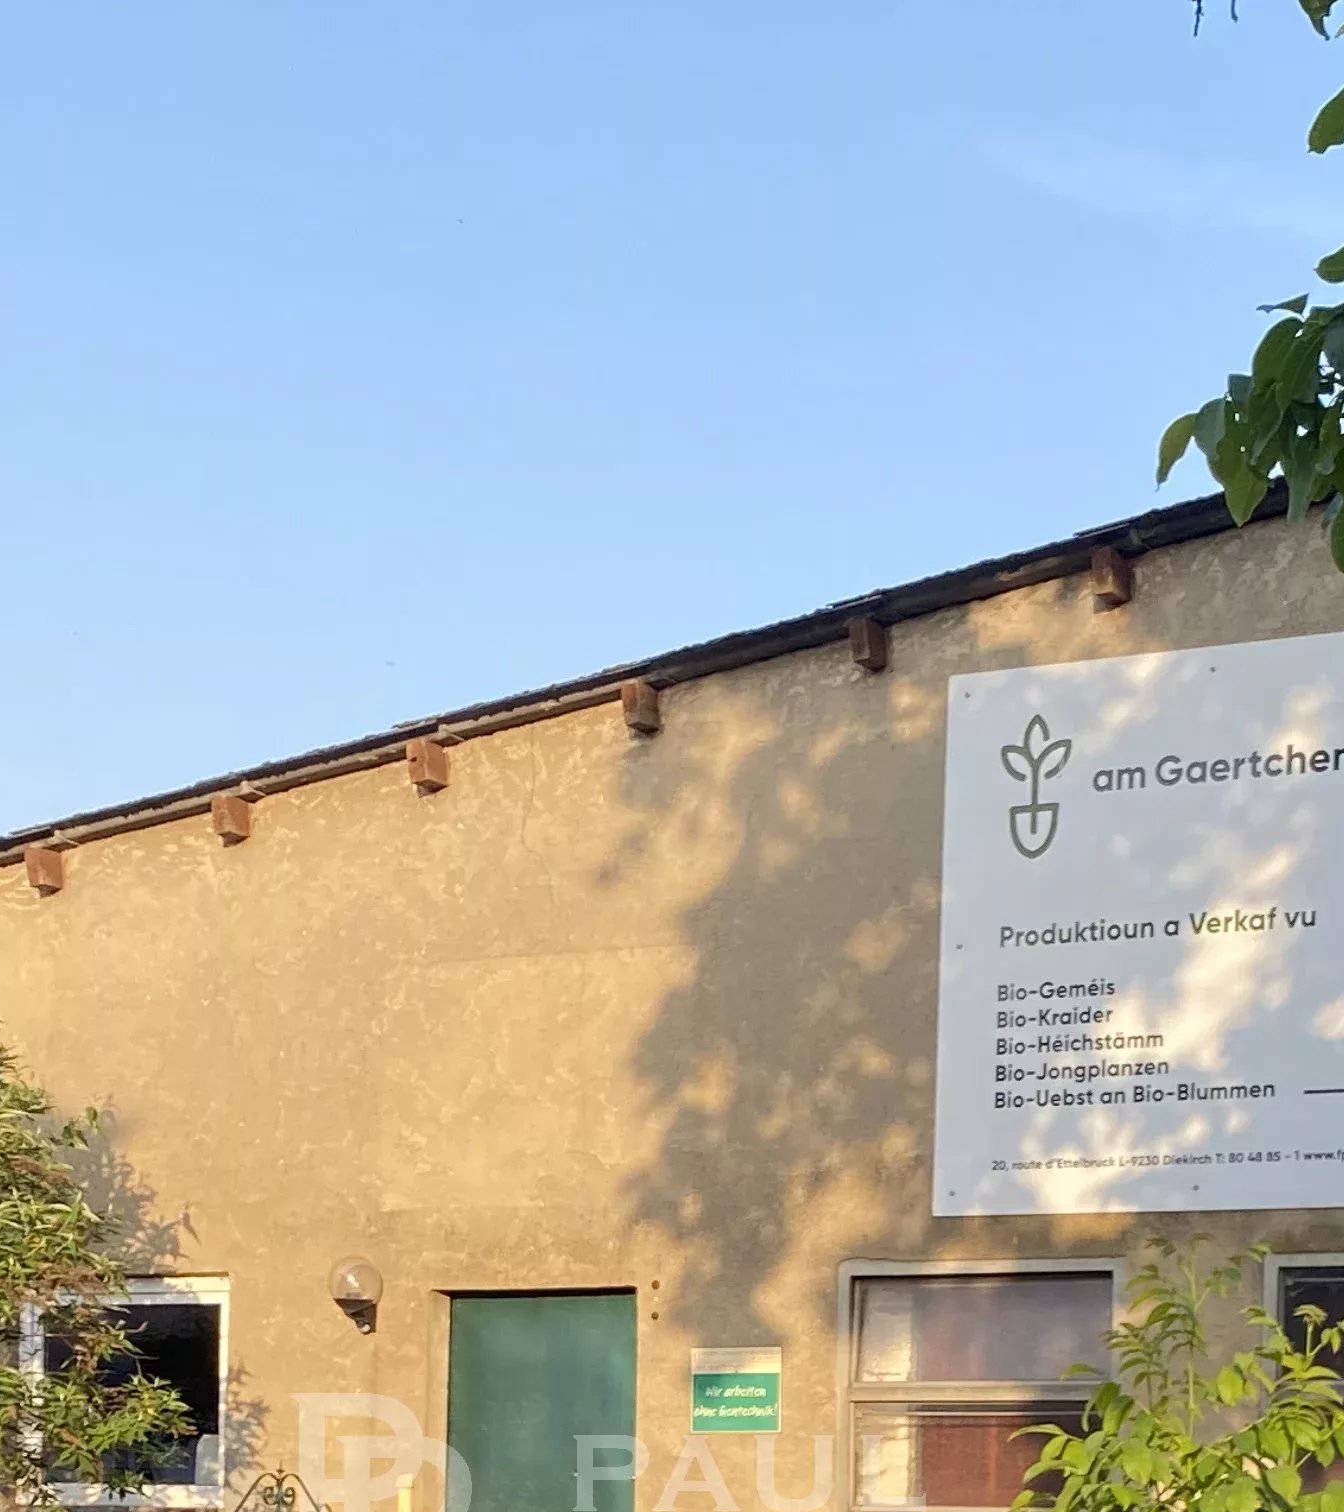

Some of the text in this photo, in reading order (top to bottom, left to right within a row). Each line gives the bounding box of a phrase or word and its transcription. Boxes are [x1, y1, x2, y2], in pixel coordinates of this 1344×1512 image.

[1092, 766, 1147, 793] am
[999, 906, 1317, 948] Produktioun a Verkaf vu
[996, 978, 1116, 1002] Bio-Geméis
[995, 1006, 1114, 1029] Bio-Kraider
[995, 1031, 1164, 1056] Bio-Héichstämm
[994, 1059, 1170, 1083] Bio-Jongplanzen
[994, 1082, 1276, 1109] Bio-Uebst an Bio-Blummen
[1011, 1160, 1042, 1170] route
[1162, 1152, 1213, 1166] Diekirch
